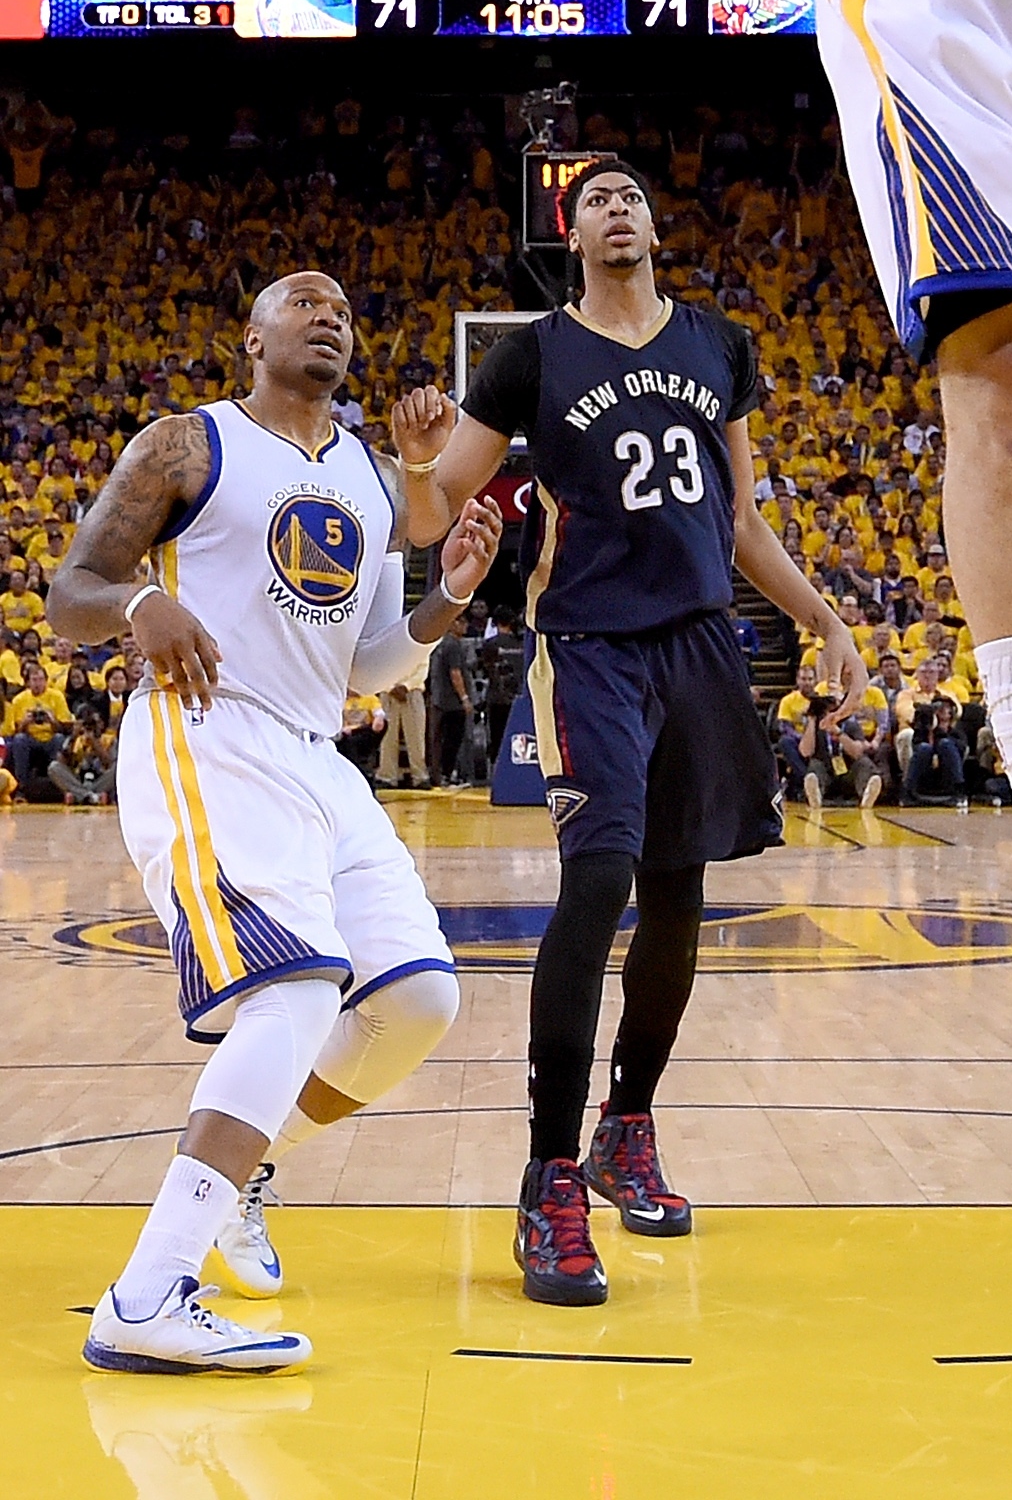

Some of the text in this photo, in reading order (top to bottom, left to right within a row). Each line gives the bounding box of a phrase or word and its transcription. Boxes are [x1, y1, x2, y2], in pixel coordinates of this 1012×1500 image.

[96, 4, 230, 25] TF 0 TOL 3 1
[480, 3, 585, 33] 11:05
[564, 369, 720, 431] NEW ORLEANS
[614, 425, 704, 511] 23
[267, 483, 320, 509] GOLDEN
[325, 518, 343, 546] 5
